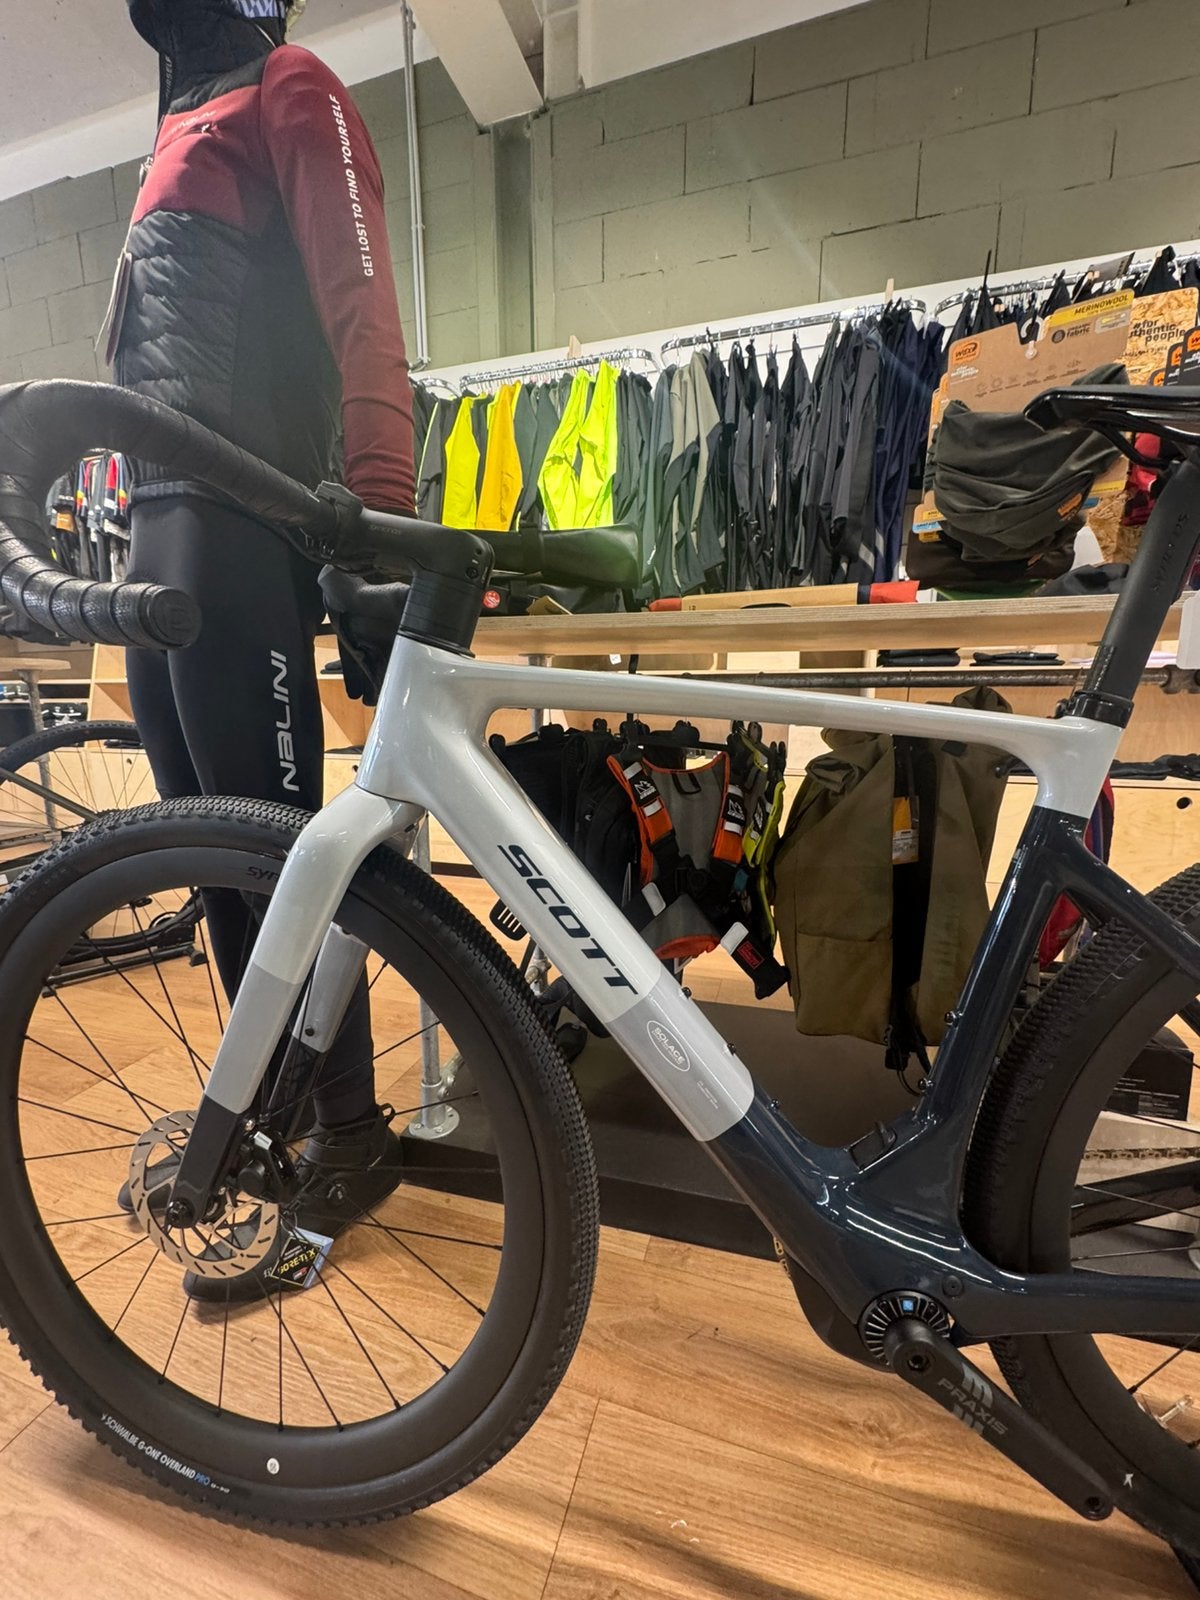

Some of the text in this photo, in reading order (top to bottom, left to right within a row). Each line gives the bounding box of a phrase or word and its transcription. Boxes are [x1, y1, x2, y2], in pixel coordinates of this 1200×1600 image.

[328, 93, 374, 277] GET LOST TO FIND YOURSELF
[497, 844, 639, 995] SCOTT
[653, 1026, 686, 1065] SOLACE
[937, 1378, 1009, 1436] PRAXIS
[105, 1416, 211, 1487] SCHWALBE G-ONE OVERLAND PRO
